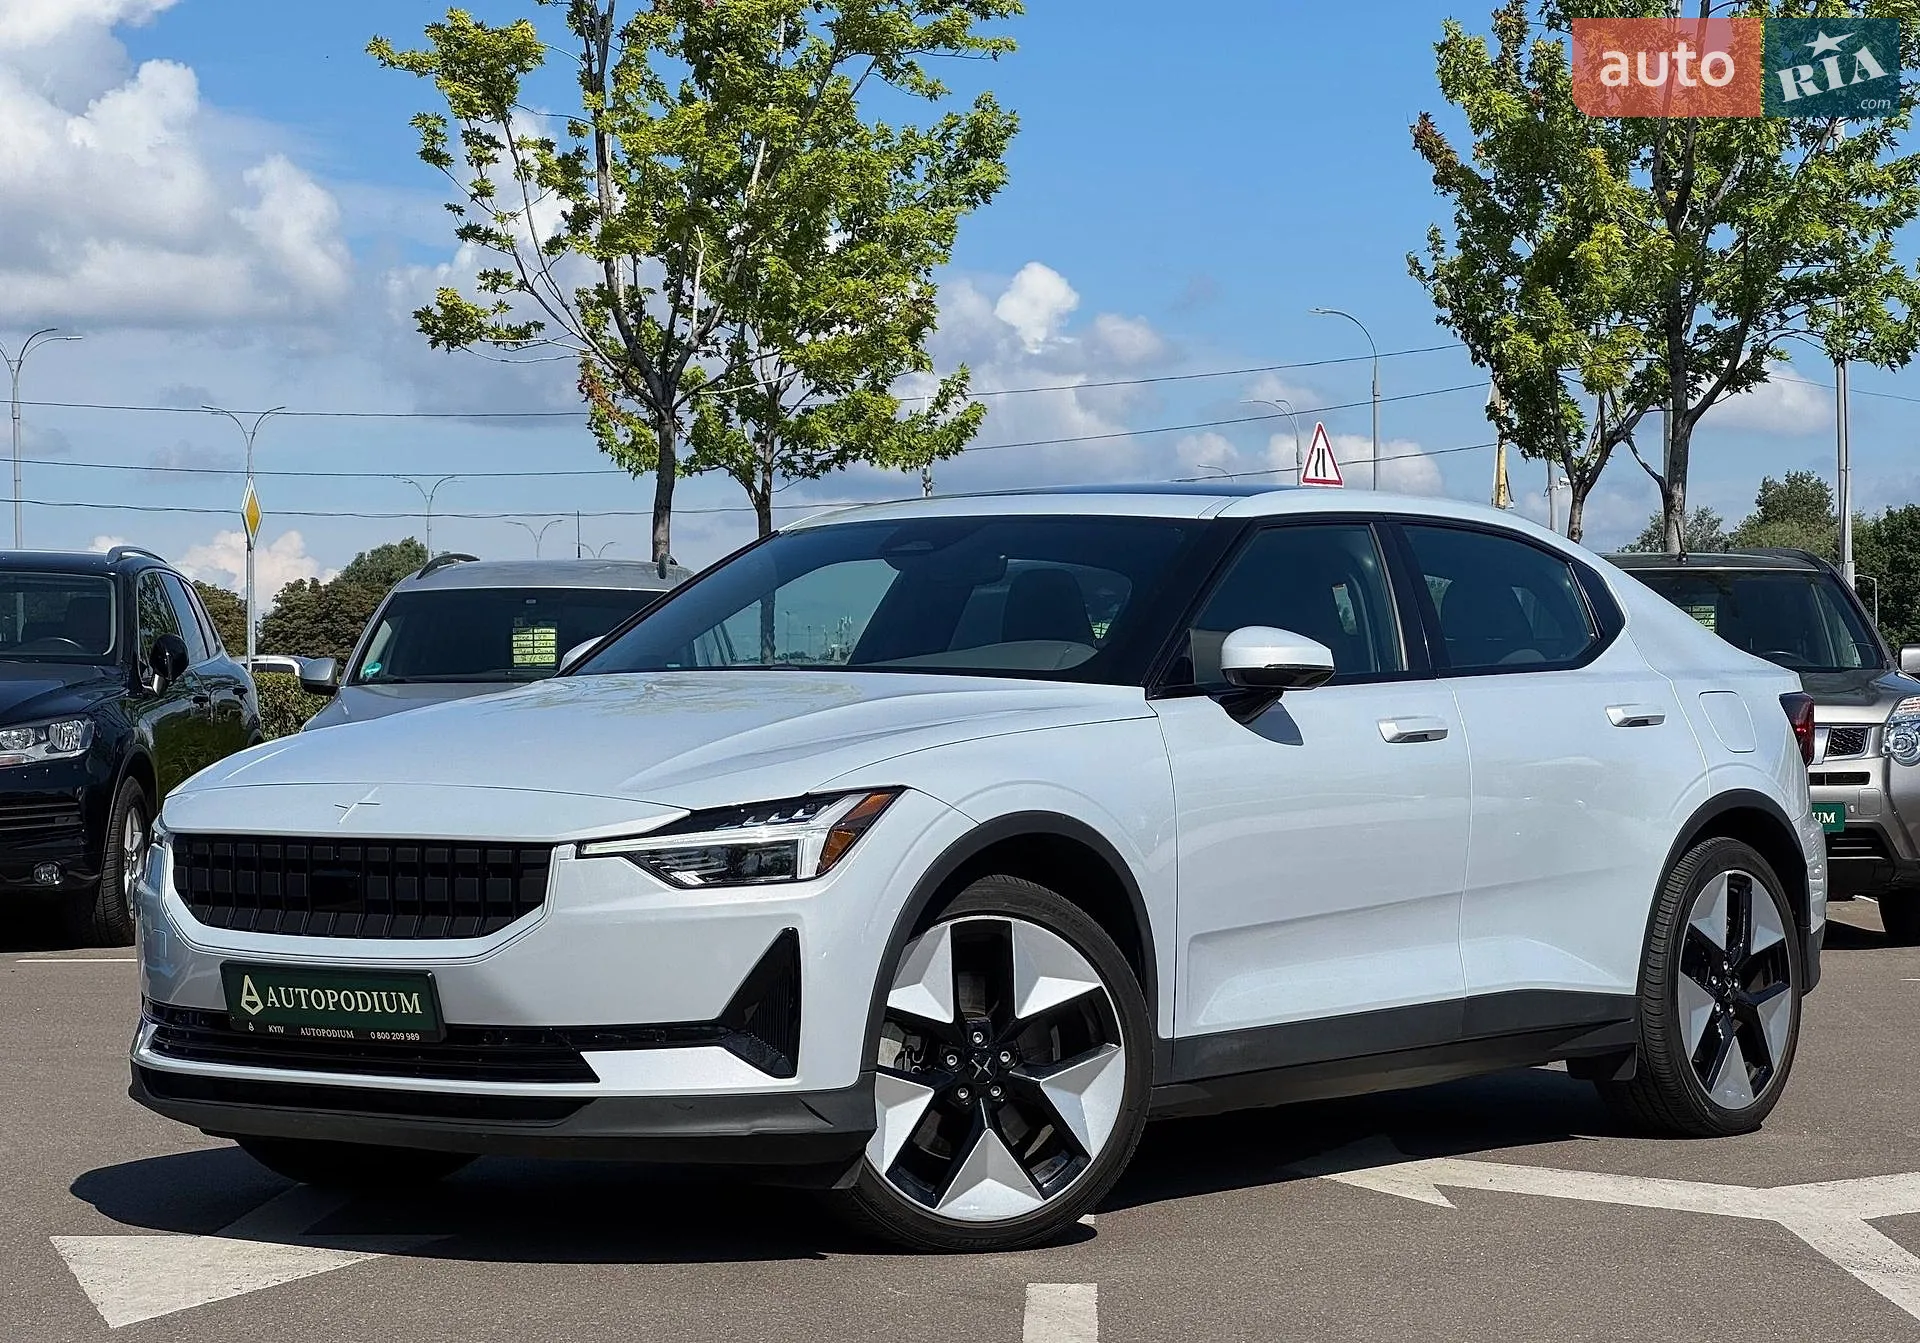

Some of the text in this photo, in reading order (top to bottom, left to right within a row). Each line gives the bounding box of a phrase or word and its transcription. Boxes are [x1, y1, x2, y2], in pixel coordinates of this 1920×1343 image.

[266, 985, 423, 1014] AUTOPODIUM
[268, 1024, 284, 1034] KYIV
[300, 1027, 355, 1039] AUTOPODIUM
[376, 1031, 391, 1040] 800
[391, 1031, 405, 1041] 209
[405, 1032, 420, 1041] 989
